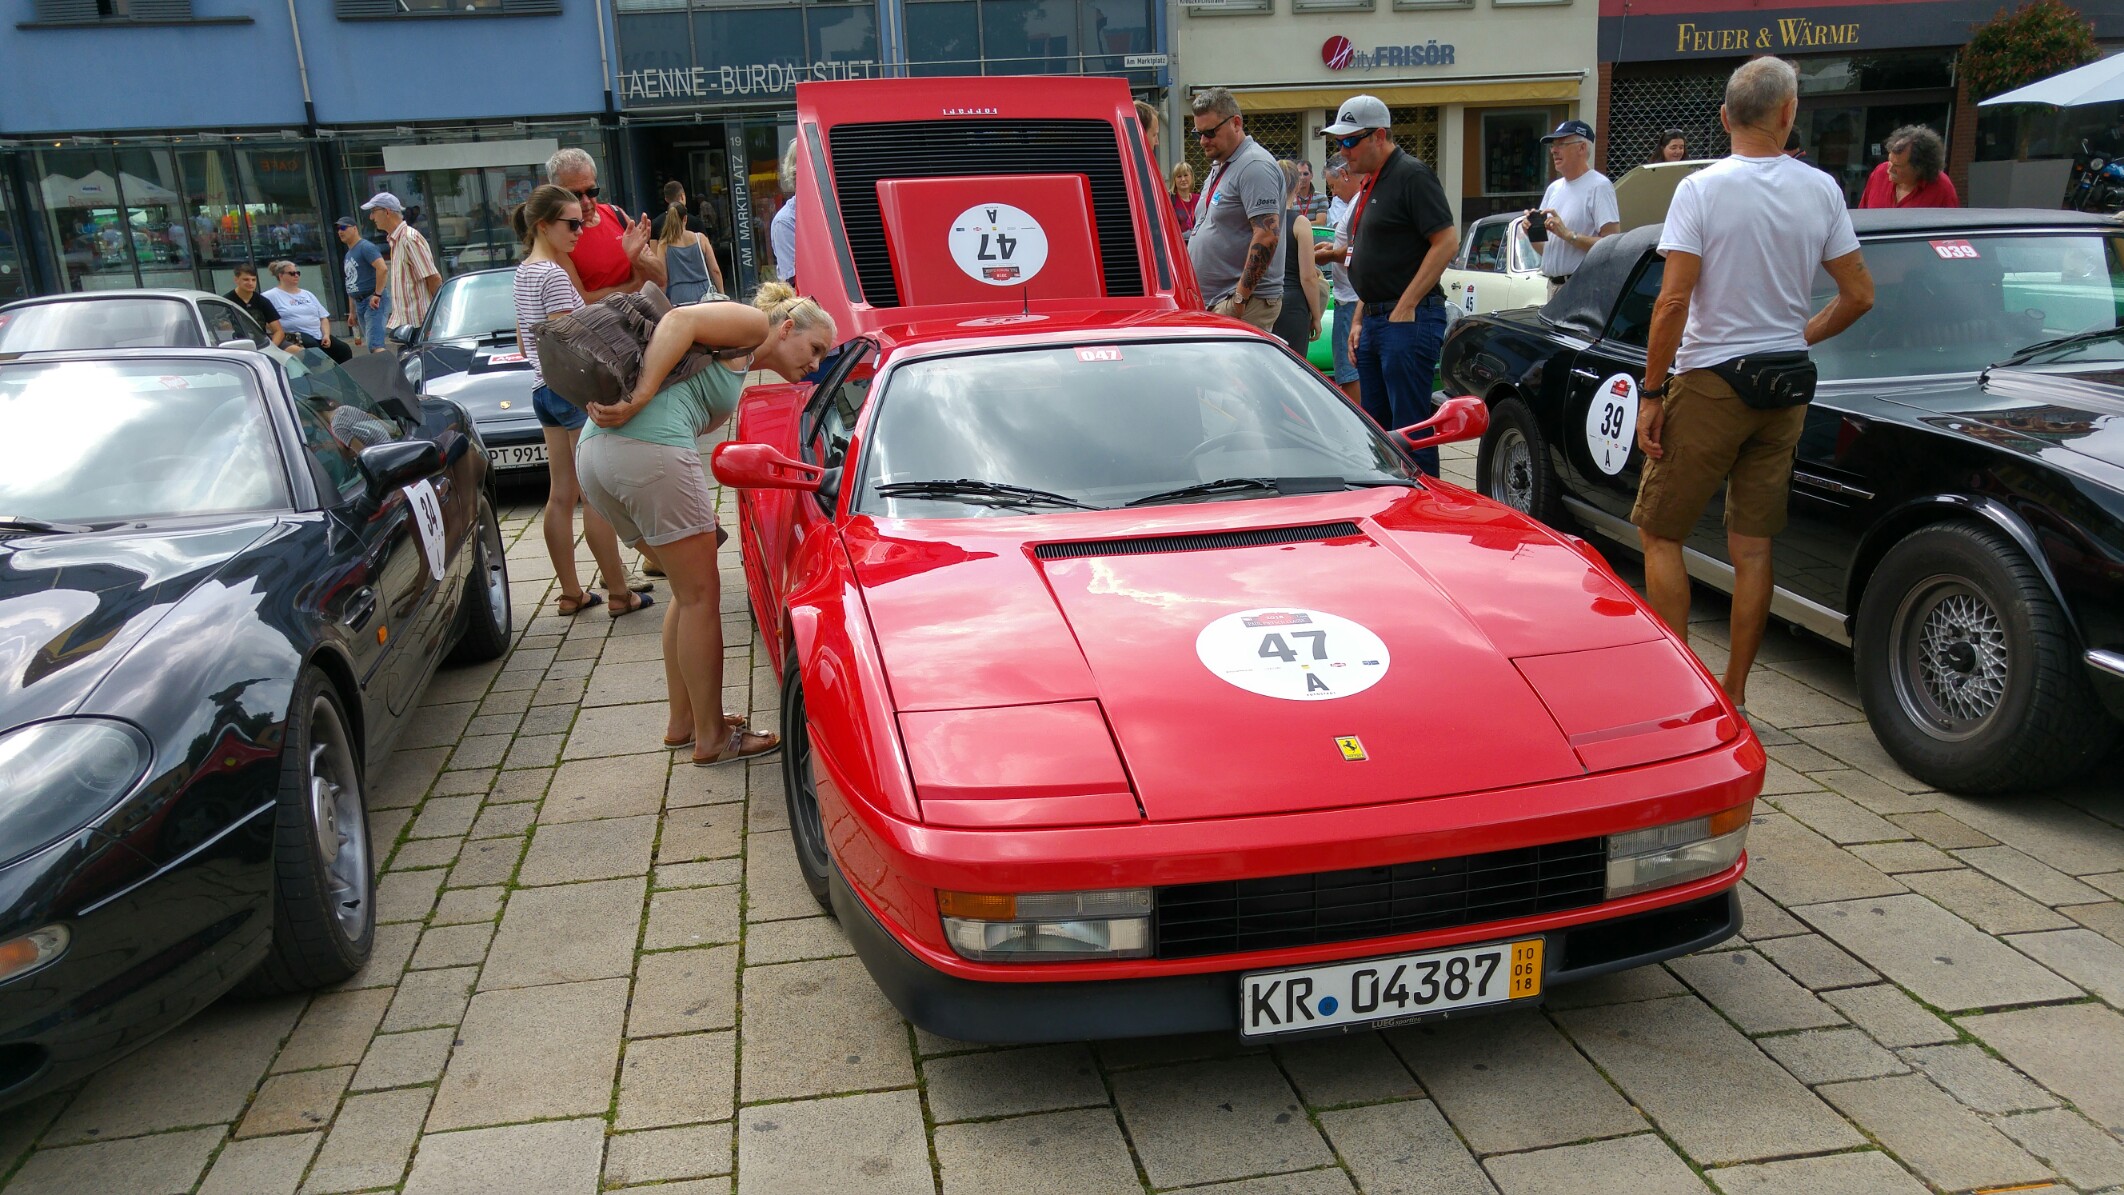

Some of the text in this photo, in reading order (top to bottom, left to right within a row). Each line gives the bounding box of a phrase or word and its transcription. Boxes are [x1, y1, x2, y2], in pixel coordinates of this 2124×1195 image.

[1675, 17, 1860, 52] FEUER & WÄRME
[1137, 57, 1166, 66] Marktplatz
[730, 136, 742, 147] 19
[732, 154, 752, 267] AM MARKTPLATZ
[986, 209, 998, 224] A
[977, 234, 1017, 261] 47
[1936, 245, 1978, 259] 039
[1465, 296, 1474, 312] 45
[1080, 350, 1117, 361] 047
[1600, 402, 1625, 440] 39
[1604, 449, 1611, 468] A
[419, 492, 438, 537] 34
[1257, 629, 1329, 663] 47
[1306, 672, 1330, 692] A
[1517, 947, 1534, 961] 10
[1514, 962, 1533, 976] 06
[1252, 952, 1502, 1027] KR 04387
[1515, 977, 1532, 991] 18
